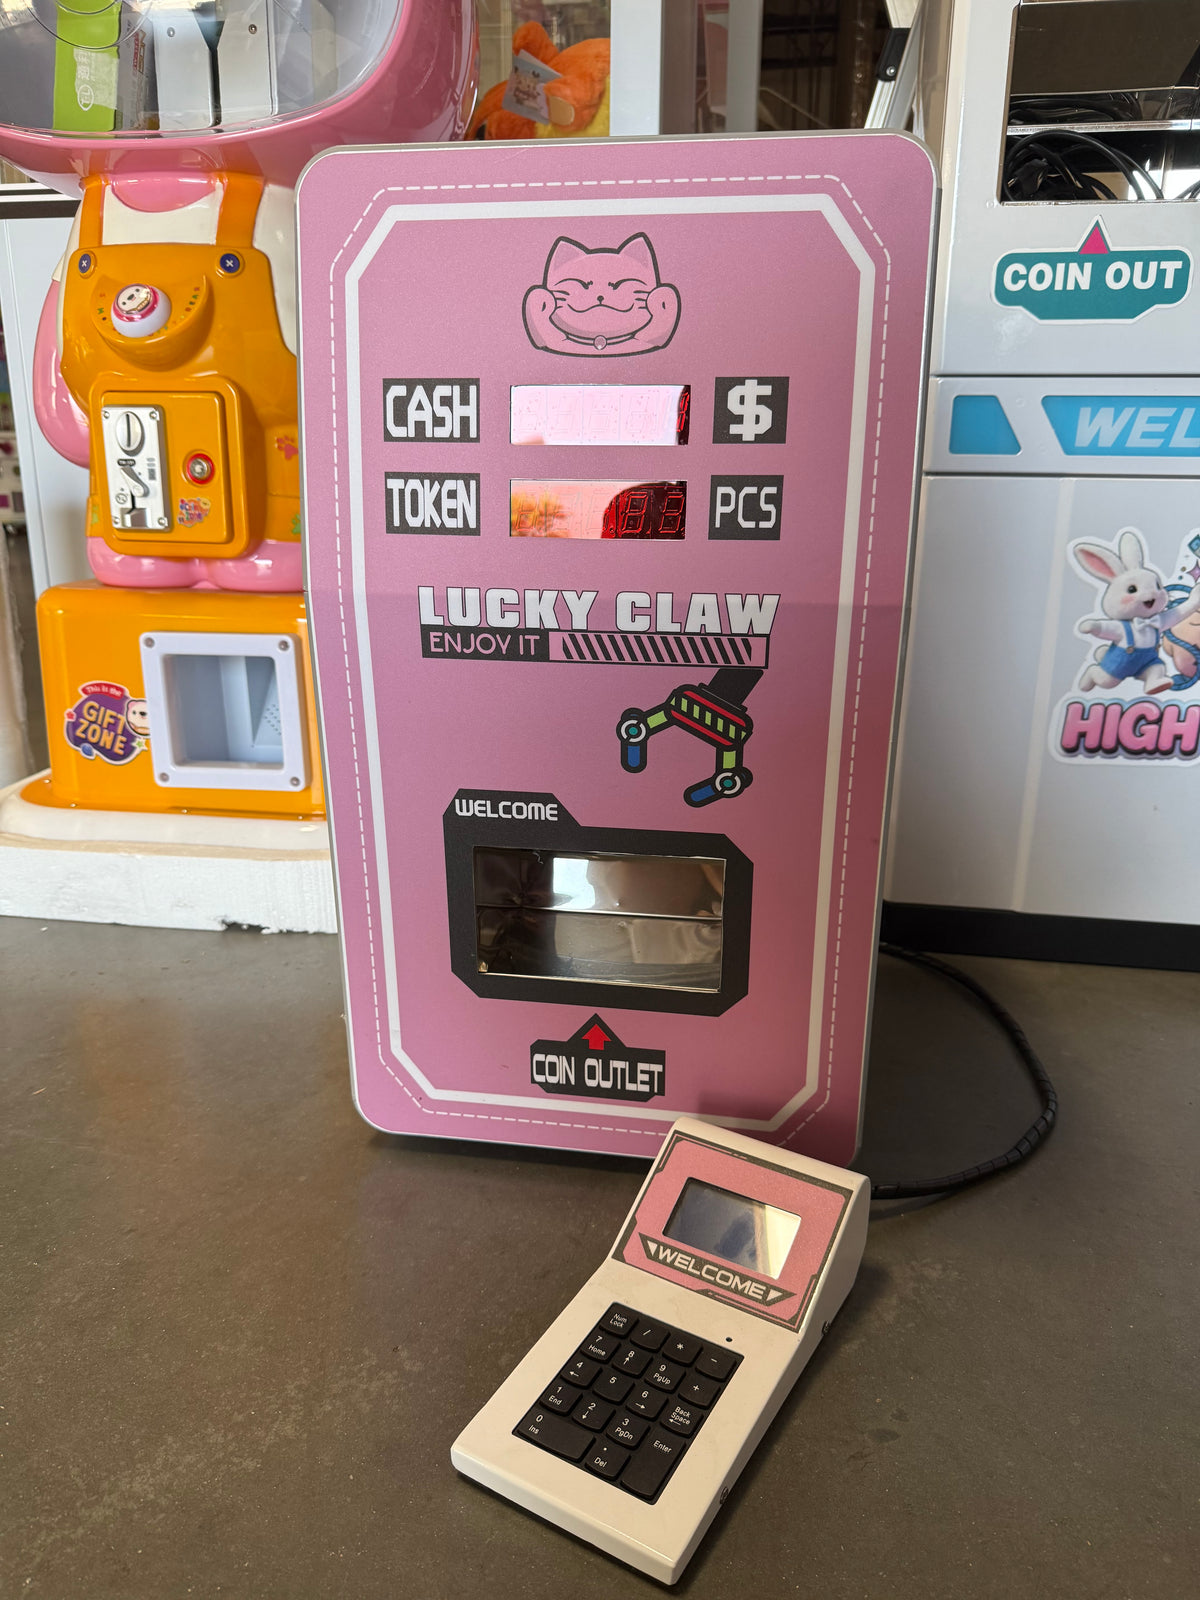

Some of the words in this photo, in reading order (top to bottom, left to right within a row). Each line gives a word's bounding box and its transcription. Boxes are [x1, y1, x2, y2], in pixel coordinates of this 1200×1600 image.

[1003, 262, 1093, 291] COIN
[1105, 261, 1183, 290] OUT
[386, 385, 477, 438] CASH
[727, 379, 773, 441] $
[1074, 407, 1200, 448] WEL
[387, 478, 476, 528] TOKEN
[715, 486, 777, 528] PCS
[418, 586, 599, 630] LUCKY
[616, 591, 781, 635] CLAW
[430, 631, 513, 655] ENJOY
[519, 634, 540, 656] IT
[83, 701, 126, 735] GIFT
[1060, 700, 1200, 755] HIGH
[75, 718, 127, 755] ZONE
[455, 799, 558, 821] WELCOME
[532, 1053, 575, 1085] COIN
[584, 1058, 663, 1093] OUTLET
[658, 1245, 767, 1299] WELCOME
[609, 1319, 624, 1328] Lock
[613, 1313, 628, 1323] Num
[588, 1344, 606, 1356] Home
[628, 1350, 635, 1358] 8
[659, 1364, 667, 1372] 9
[609, 1376, 617, 1384] 5
[653, 1372, 671, 1385] PgUp
[548, 1395, 562, 1405] End
[641, 1390, 649, 1398] 6
[588, 1402, 596, 1410] 2
[674, 1406, 691, 1418] Back
[535, 1414, 544, 1423] 0
[622, 1418, 630, 1426] 3
[670, 1412, 691, 1425] Space
[528, 1424, 540, 1435] Ins
[615, 1427, 634, 1440] PgDn
[653, 1440, 672, 1453] Enter
[594, 1456, 607, 1468] Del
